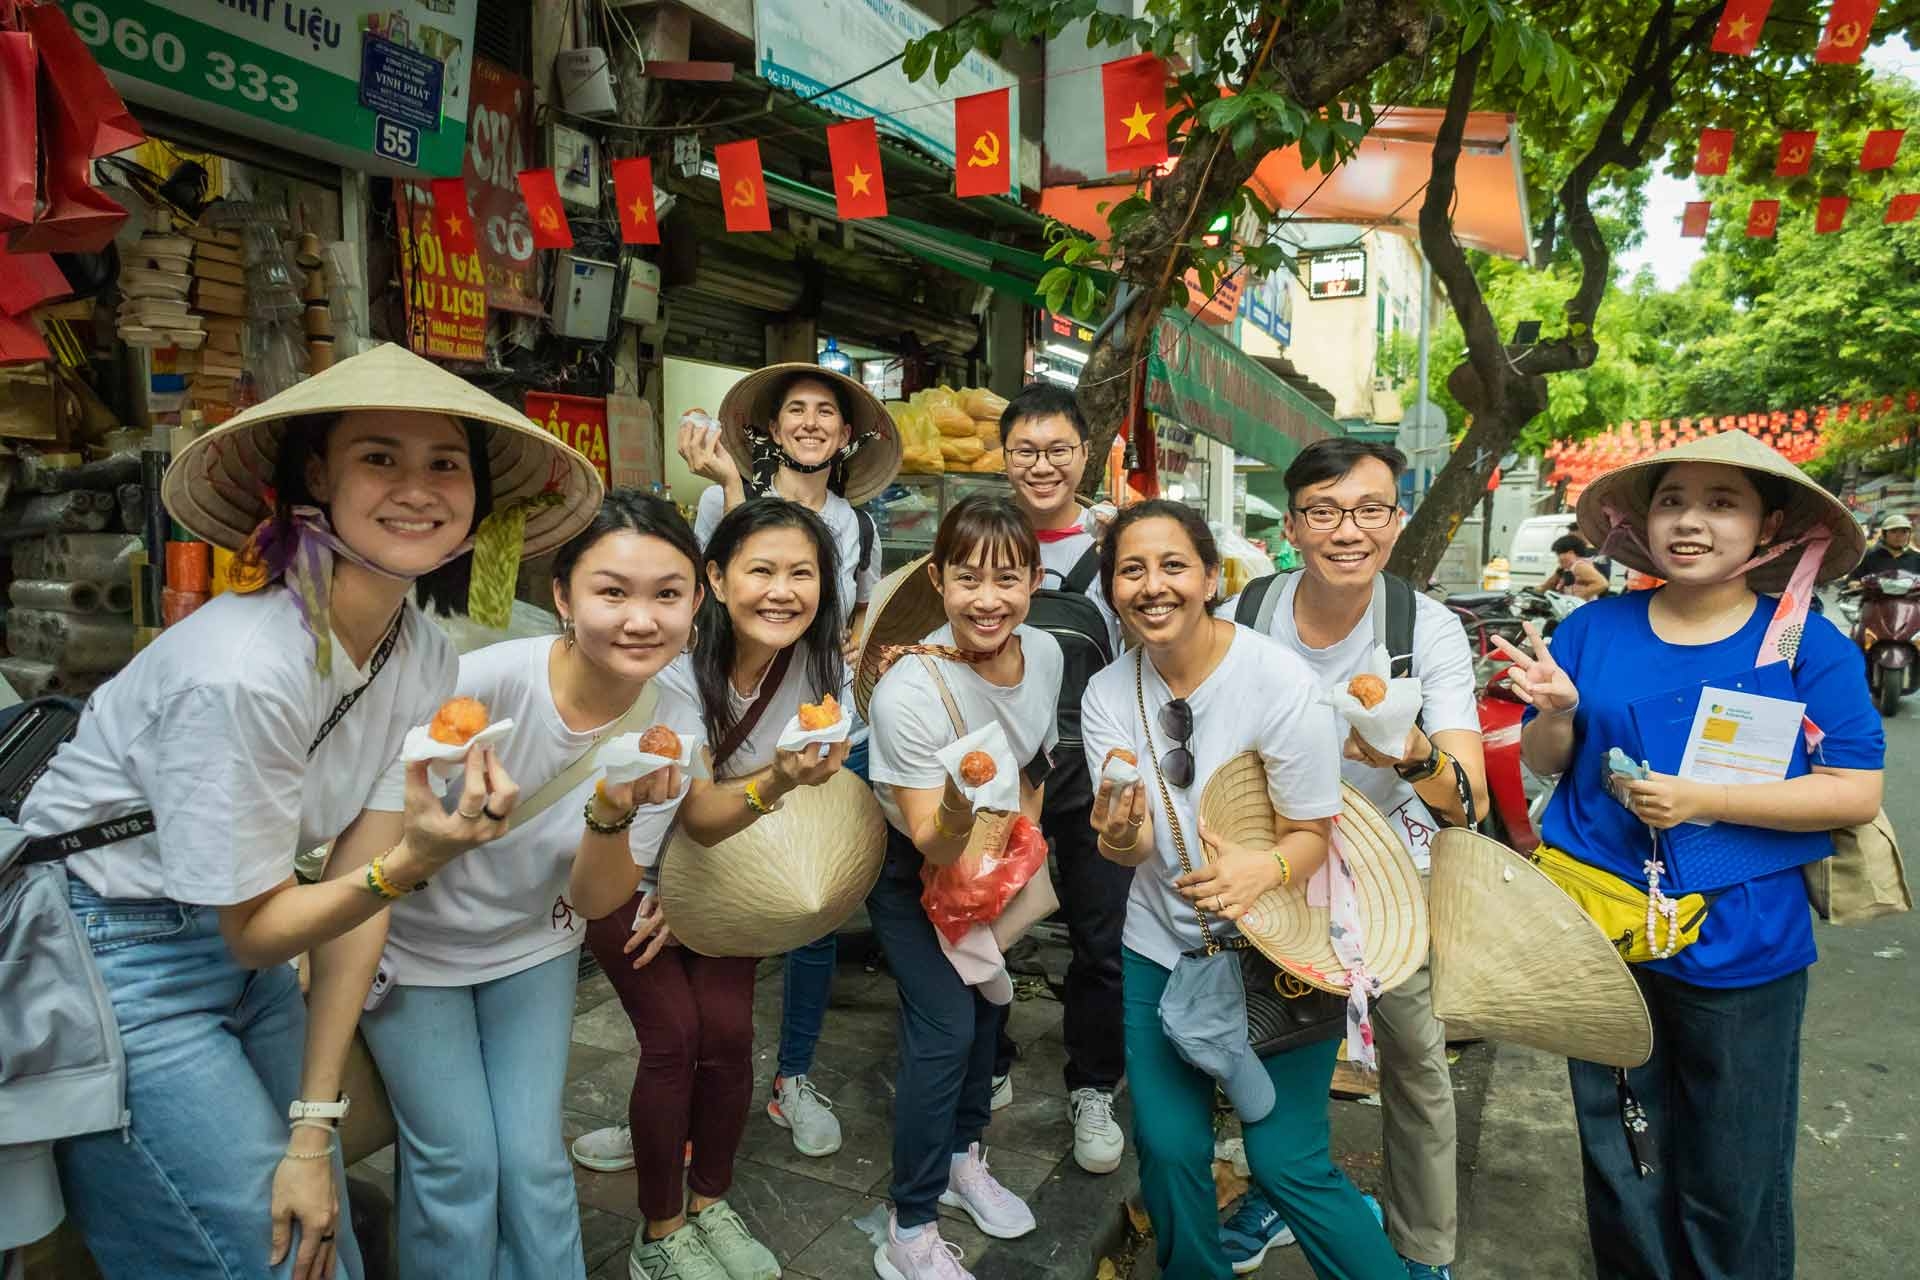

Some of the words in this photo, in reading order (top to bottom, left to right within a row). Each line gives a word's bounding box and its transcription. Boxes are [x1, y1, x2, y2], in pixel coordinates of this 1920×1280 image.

[285, 3, 341, 51] LIỆU
[72, 3, 186, 73] 960
[204, 51, 299, 113] 333
[383, 124, 412, 158] 55
[441, 285, 486, 320] LỊCH
